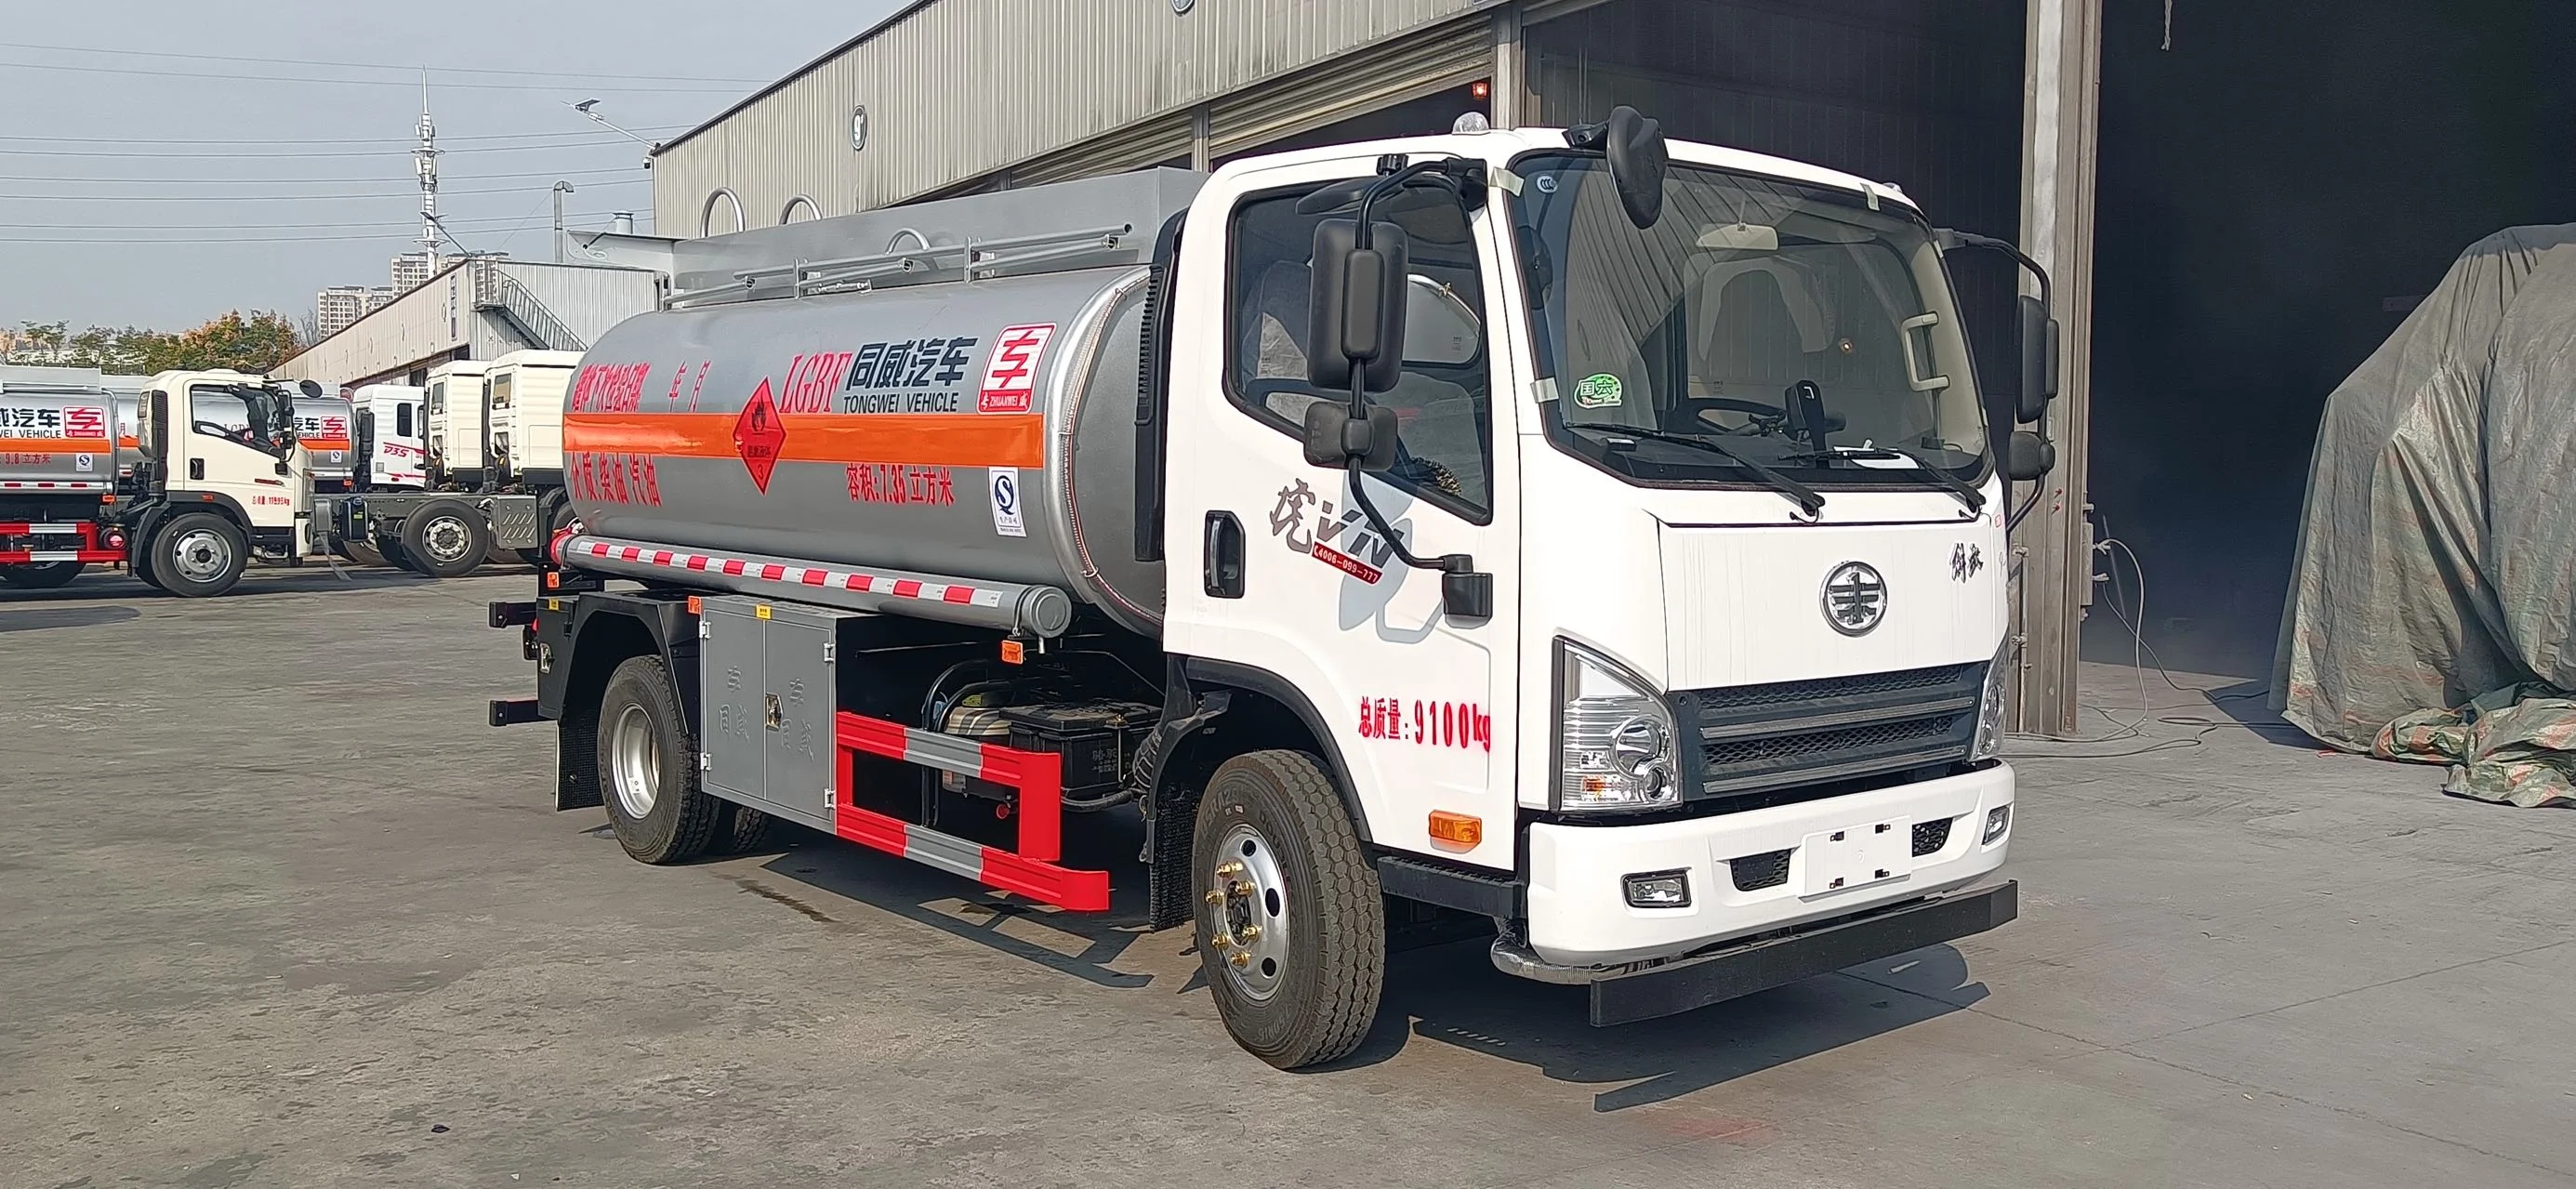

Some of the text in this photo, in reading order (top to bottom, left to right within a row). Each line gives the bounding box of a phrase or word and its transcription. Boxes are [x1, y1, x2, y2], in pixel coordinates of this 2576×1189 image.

[846, 337, 979, 390] 同威汽车
[1580, 380, 1613, 395] 国六
[844, 391, 958, 414] TONGWEI VEHICLE
[19, 429, 61, 439] VEHICLE
[1318, 548, 1380, 583] 4006-099-777
